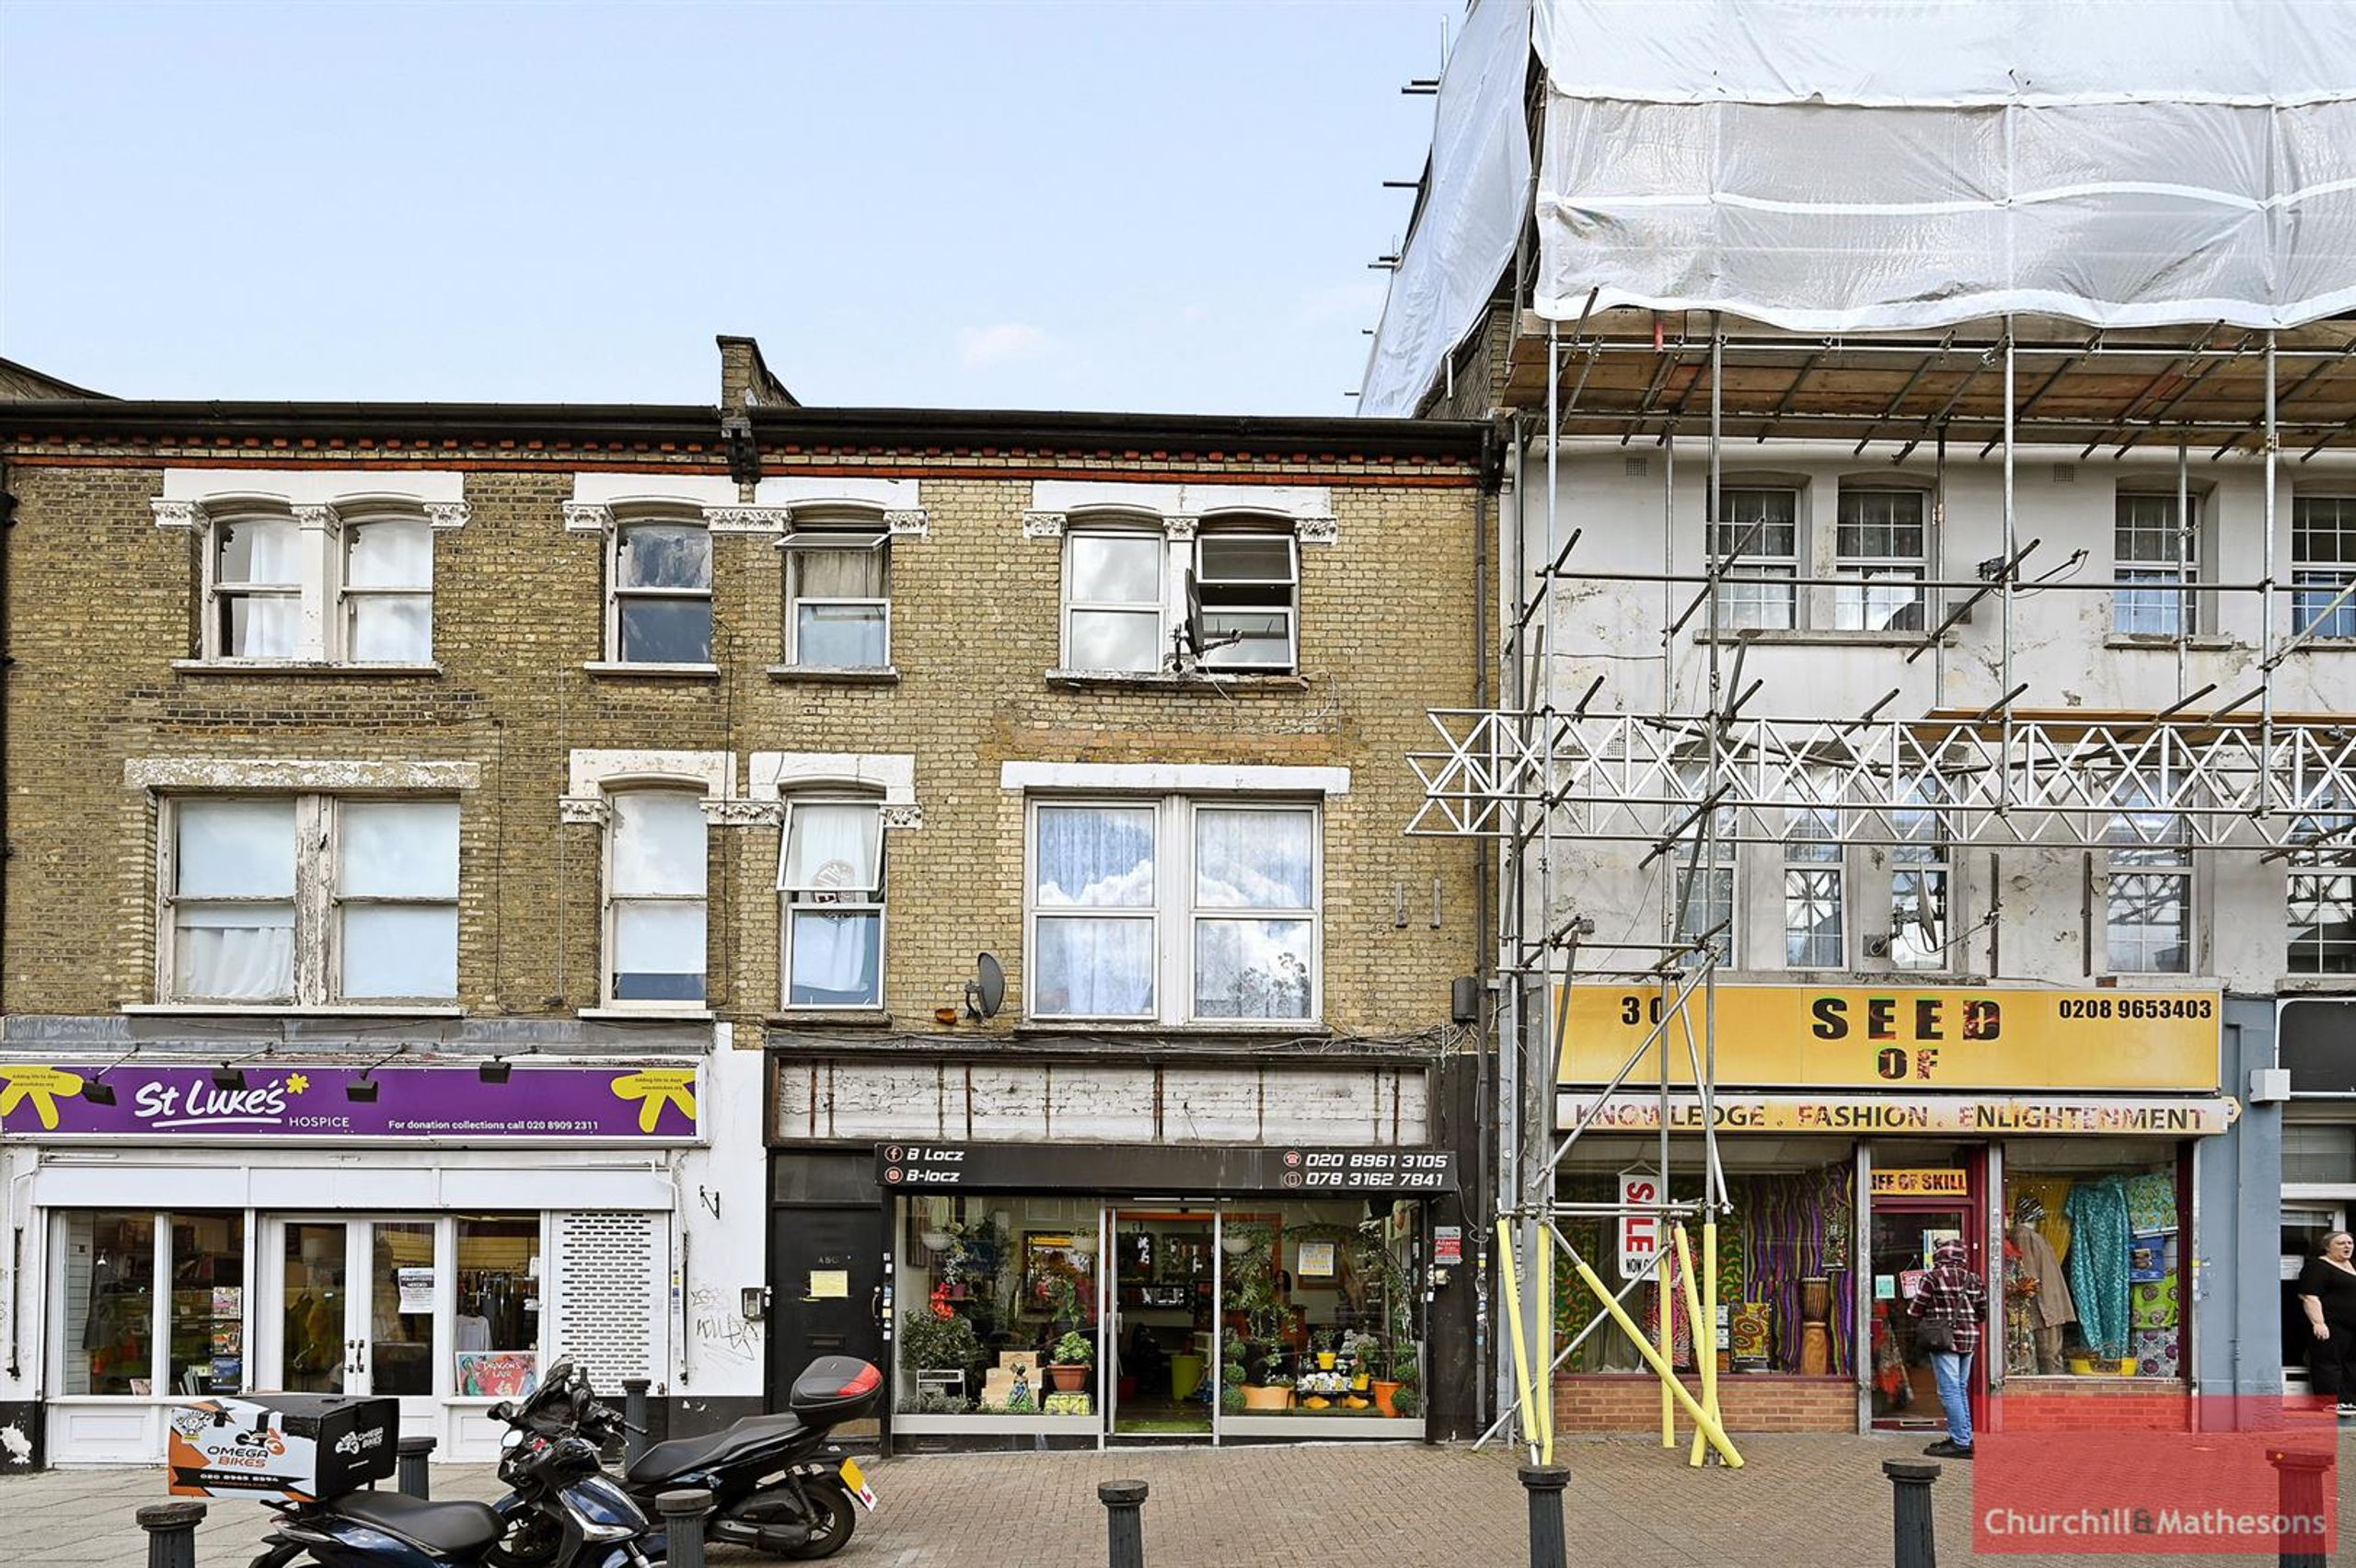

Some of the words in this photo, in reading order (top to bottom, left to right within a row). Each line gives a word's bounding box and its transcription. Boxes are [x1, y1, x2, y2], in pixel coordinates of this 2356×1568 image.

[2059, 999, 2111, 1019] 0208
[2118, 999, 2212, 1019] 9653403
[1812, 997, 2000, 1040] SEED
[1877, 1047, 1938, 1079] OF
[134, 1081, 179, 1117] St
[289, 1116, 350, 1127] HOSPICE
[1576, 1104, 1765, 1126] KNOWLEDGE
[1798, 1105, 1927, 1127] FASHION
[1959, 1105, 2206, 1129] ENLIGHTENMENT
[388, 1120, 405, 1129] For
[407, 1120, 450, 1129] donation
[452, 1120, 504, 1130] collections
[507, 1120, 525, 1129] call
[526, 1120, 545, 1129] 020
[548, 1120, 572, 1130] 8909
[574, 1120, 598, 1130] 2311
[907, 1147, 919, 1160] B
[924, 1147, 964, 1160] Locz
[1306, 1154, 1344, 1167] 020
[1349, 1154, 1396, 1168] 8961
[1401, 1155, 1448, 1168] 3105
[906, 1170, 960, 1182] B-locz
[1306, 1172, 1343, 1185] 078
[1348, 1173, 1395, 1185] 3162
[1400, 1173, 1443, 1186] 7841
[1870, 1174, 1894, 1190] IFE
[1899, 1174, 1917, 1190] OF
[1922, 1174, 1966, 1190] SKILL
[1626, 1258, 1643, 1273] NOW
[207, 1446, 269, 1458] OMEGA
[218, 1456, 267, 1468] BIKES
